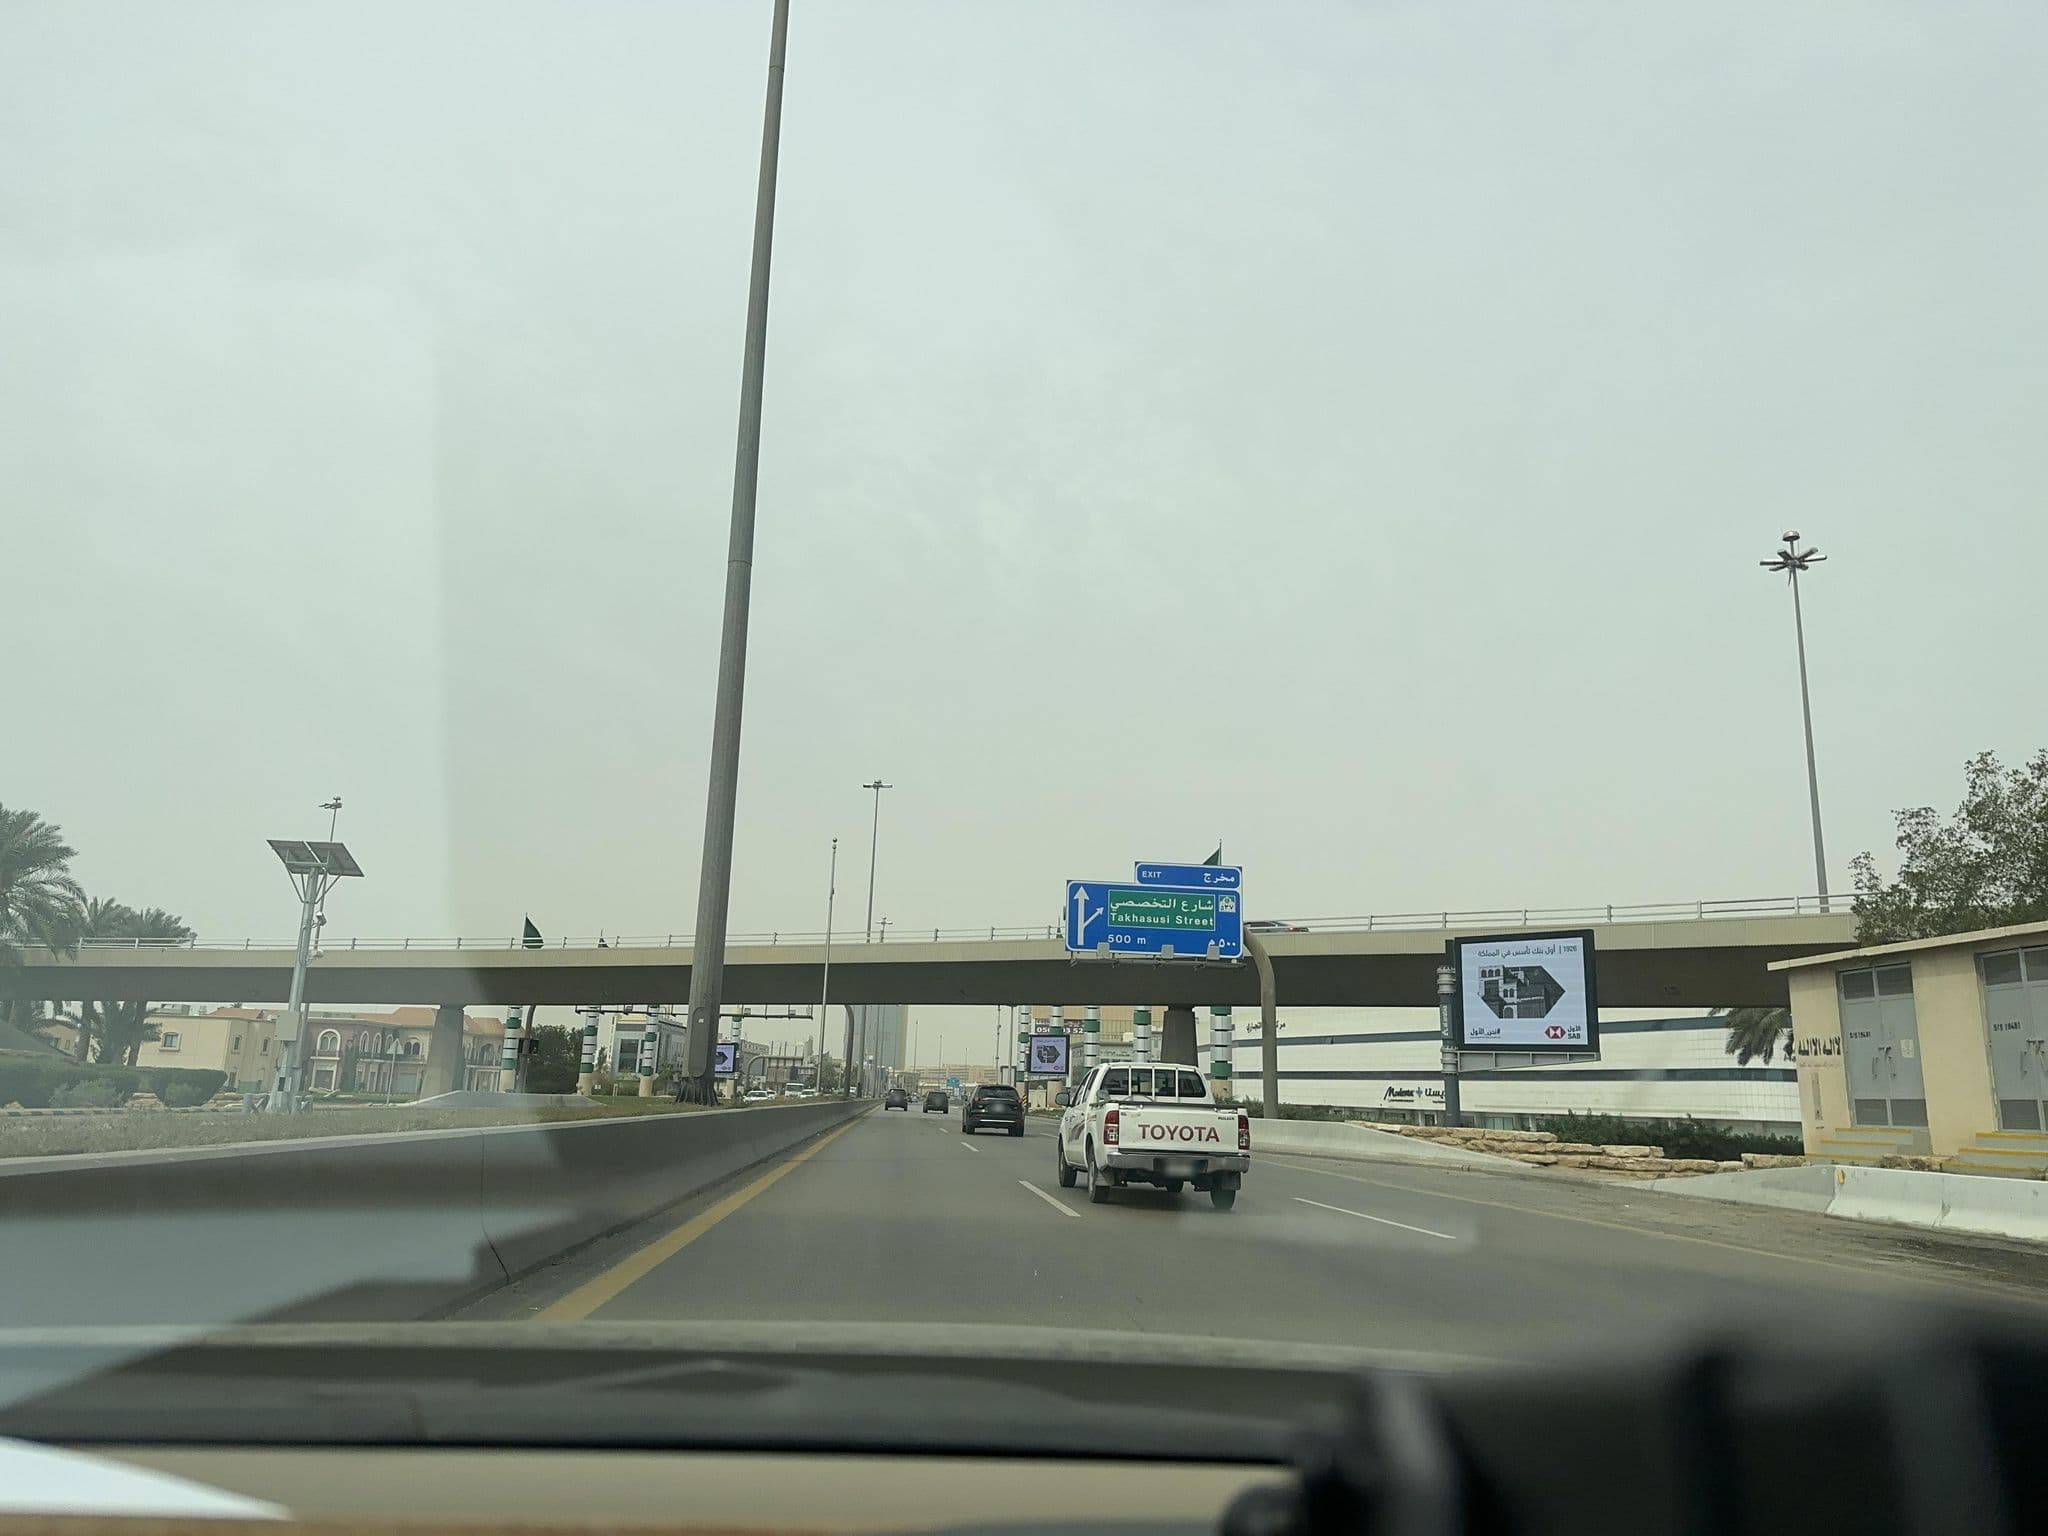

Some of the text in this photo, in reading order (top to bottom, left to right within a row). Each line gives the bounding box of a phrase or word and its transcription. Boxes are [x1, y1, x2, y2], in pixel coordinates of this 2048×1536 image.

[1141, 870, 1162, 879] EXIT
[1203, 872, 1236, 884] مخرج
[1110, 898, 1214, 912] شارع التخصصي
[1110, 912, 1214, 926] Takhasusi Street
[1107, 934, 1131, 944] 500
[1218, 938, 1236, 947] ٥٠٠
[1545, 944, 1555, 955] أول
[1563, 944, 1577, 952] 1926
[1478, 949, 1499, 957] المملكة
[1501, 949, 1511, 958] في
[1567, 1032, 1581, 1040] SAB
[1138, 1124, 1220, 1142] TOYOTA
